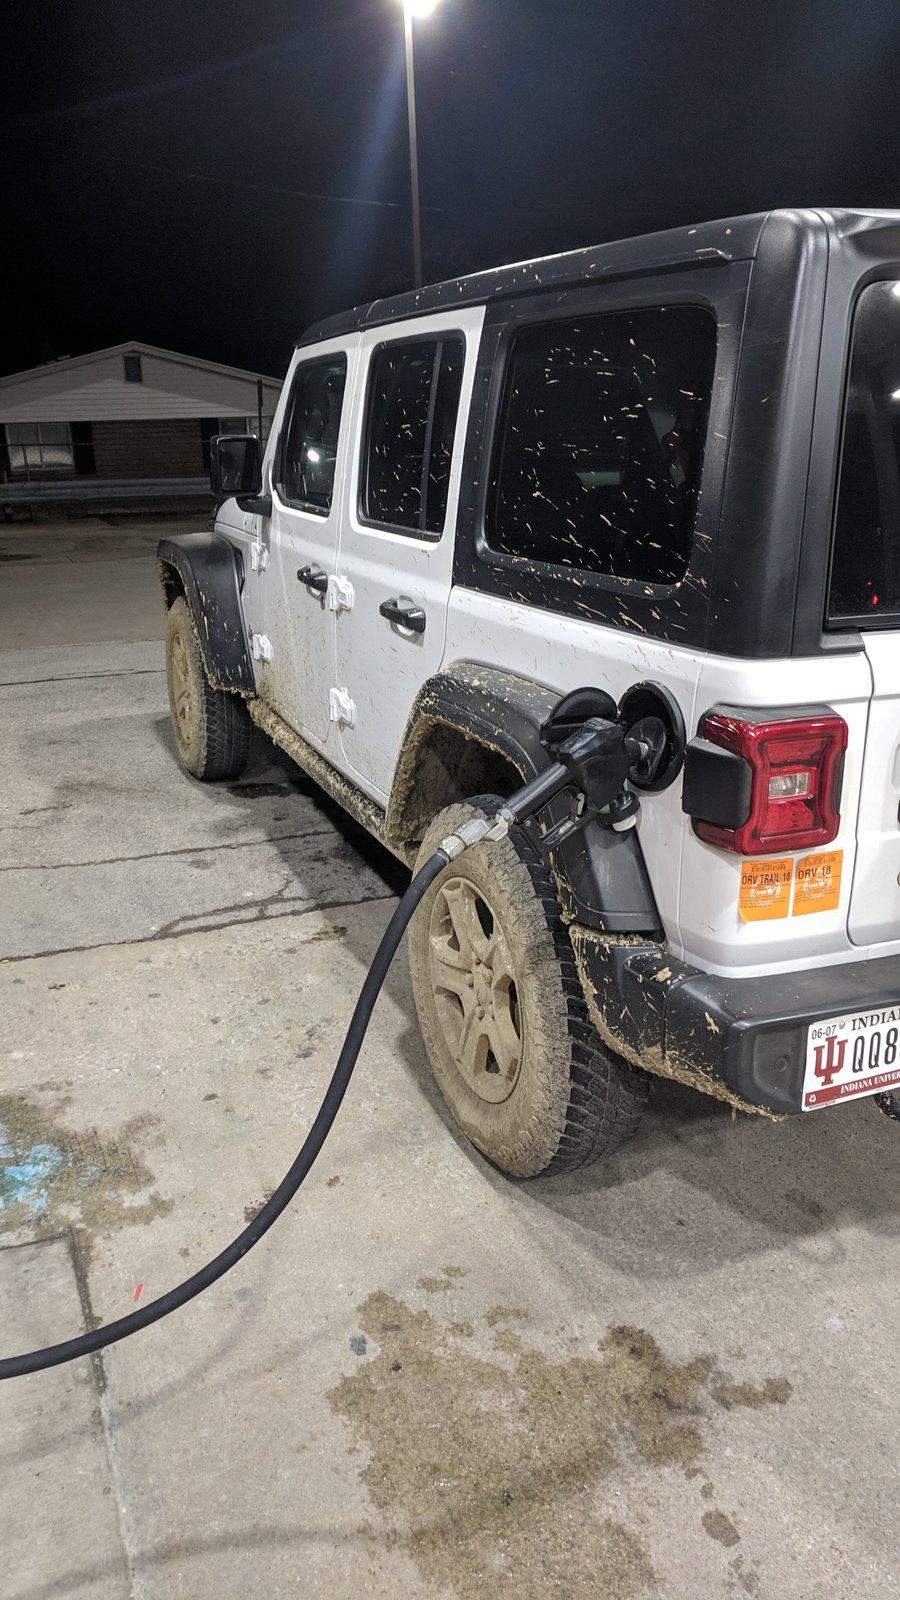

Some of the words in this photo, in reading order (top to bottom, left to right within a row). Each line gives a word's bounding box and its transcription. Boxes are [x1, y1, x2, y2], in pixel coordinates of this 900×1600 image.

[741, 875, 758, 885] ORV
[760, 873, 780, 885] TRAIL
[783, 872, 791, 882] 18
[797, 868, 818, 880] ORV
[822, 865, 832, 876] 18
[852, 1009, 900, 1031] INDIA
[812, 1025, 837, 1040] 06-07
[840, 1078, 873, 1093] INDIANA
